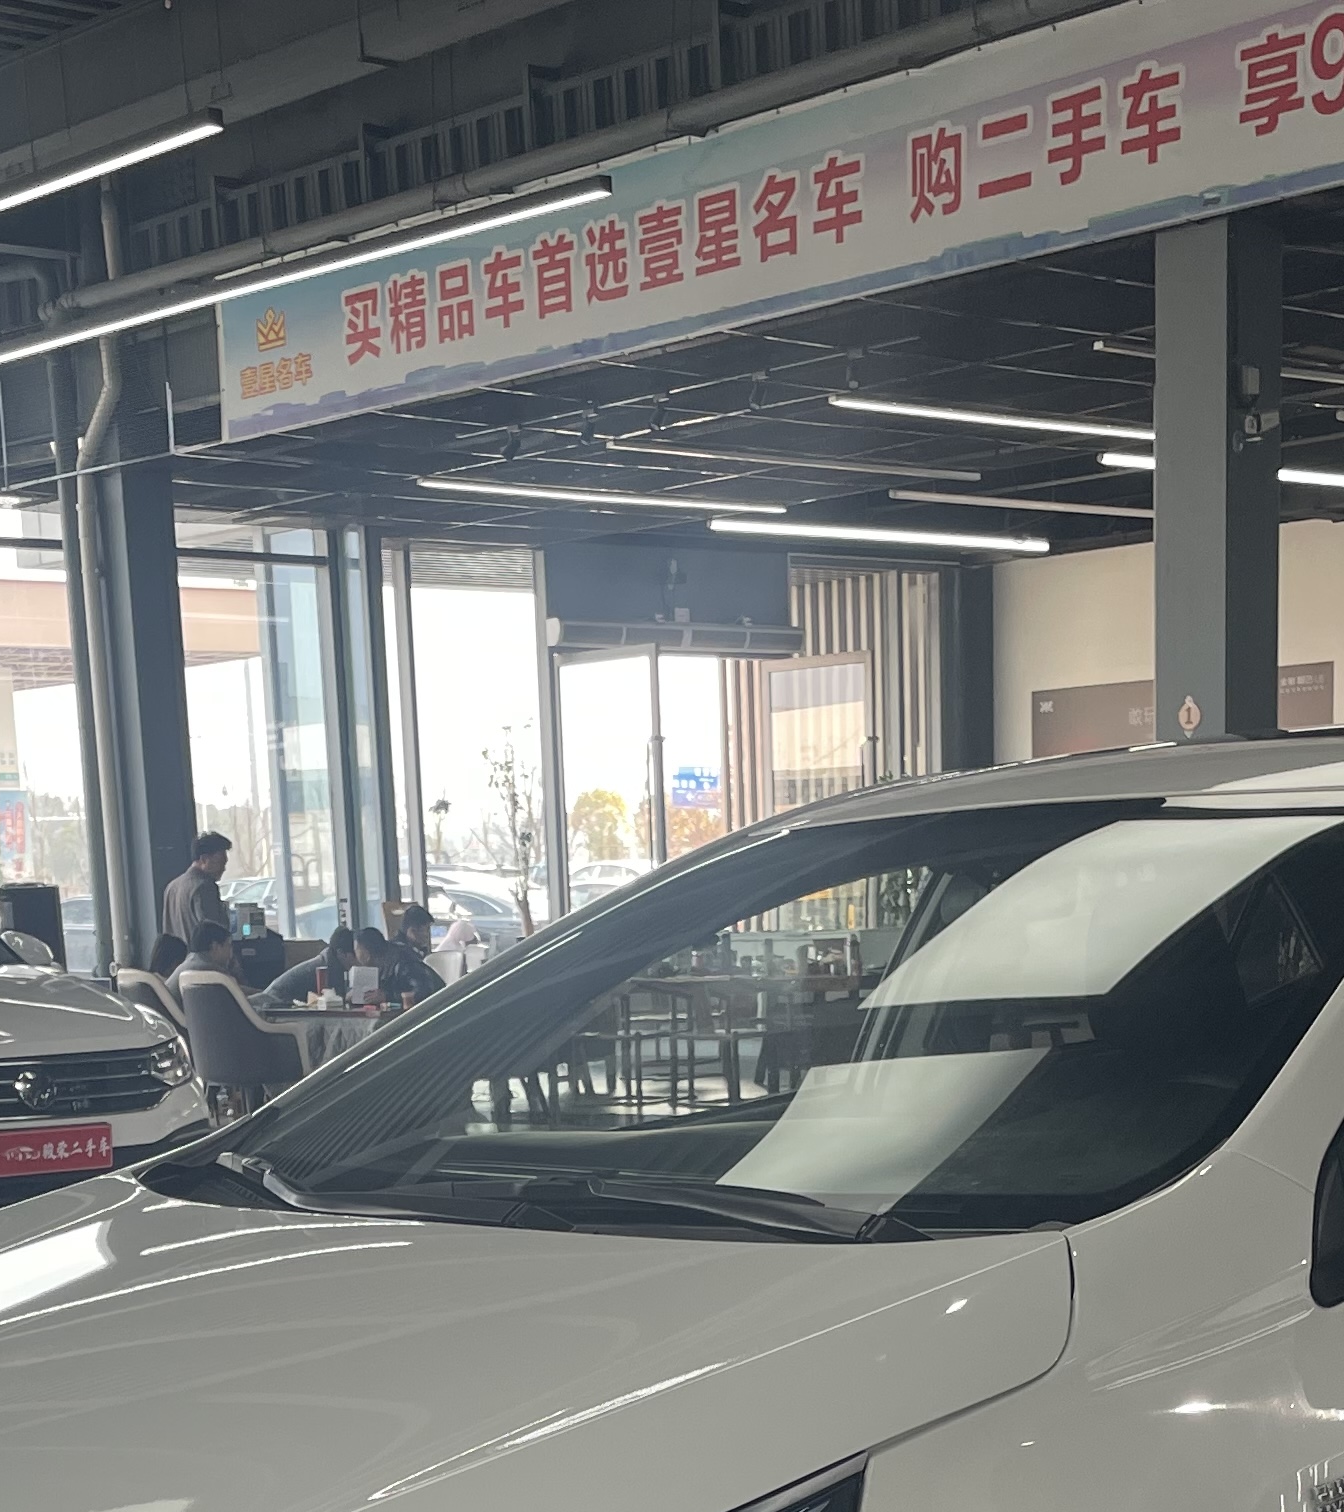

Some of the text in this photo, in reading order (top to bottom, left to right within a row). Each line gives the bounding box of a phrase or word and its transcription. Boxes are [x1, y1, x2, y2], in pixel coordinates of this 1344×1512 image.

[342, 156, 863, 366] 买精品车首选壹星名车
[910, 68, 1181, 224] 购二手车
[240, 353, 313, 399] 壹星名车
